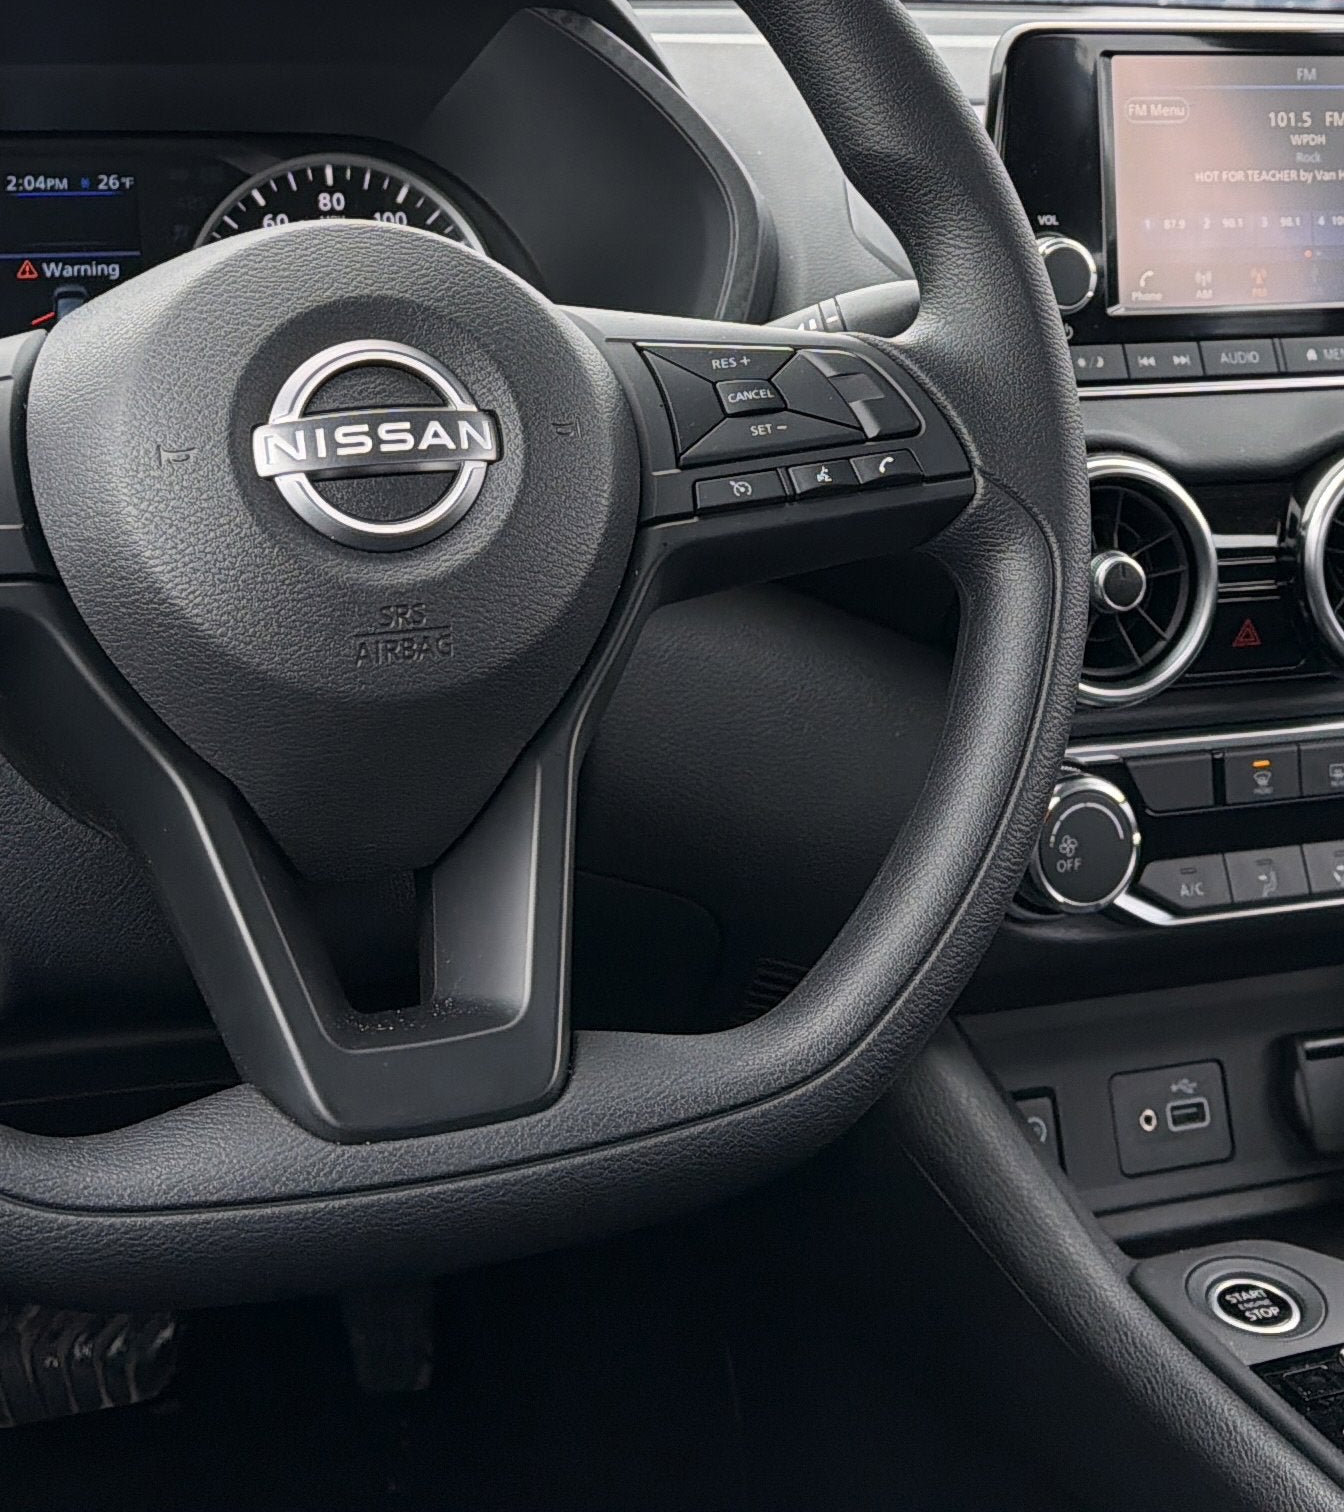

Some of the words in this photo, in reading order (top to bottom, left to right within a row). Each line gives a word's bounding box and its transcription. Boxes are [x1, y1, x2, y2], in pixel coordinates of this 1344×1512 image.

[1296, 68, 1317, 81] FM
[1128, 103, 1148, 116] FM
[1150, 103, 1186, 117] Menu
[1268, 111, 1312, 127] 101.5
[1290, 133, 1326, 146] WPDH
[1296, 151, 1321, 163] Rock
[1222, 169, 1245, 182] FOR
[1247, 169, 1298, 182] TEACHER
[1299, 169, 1313, 184] by
[1315, 169, 1338, 181] Van
[318, 192, 346, 211] 80
[262, 213, 289, 229] 60
[1037, 214, 1060, 226] VOL
[42, 261, 120, 280] Warning
[711, 357, 737, 370] RES
[1220, 350, 1260, 365] AUDIO
[727, 389, 775, 403] CANCEL
[750, 423, 773, 437] SET
[263, 420, 494, 465] NISSAN
[378, 603, 427, 629] SRS
[357, 635, 454, 667] AIRBAG
[1056, 857, 1083, 873] OFF
[1180, 882, 1204, 897] A/C
[1225, 1289, 1267, 1304] START
[1244, 1306, 1280, 1321] STOP
